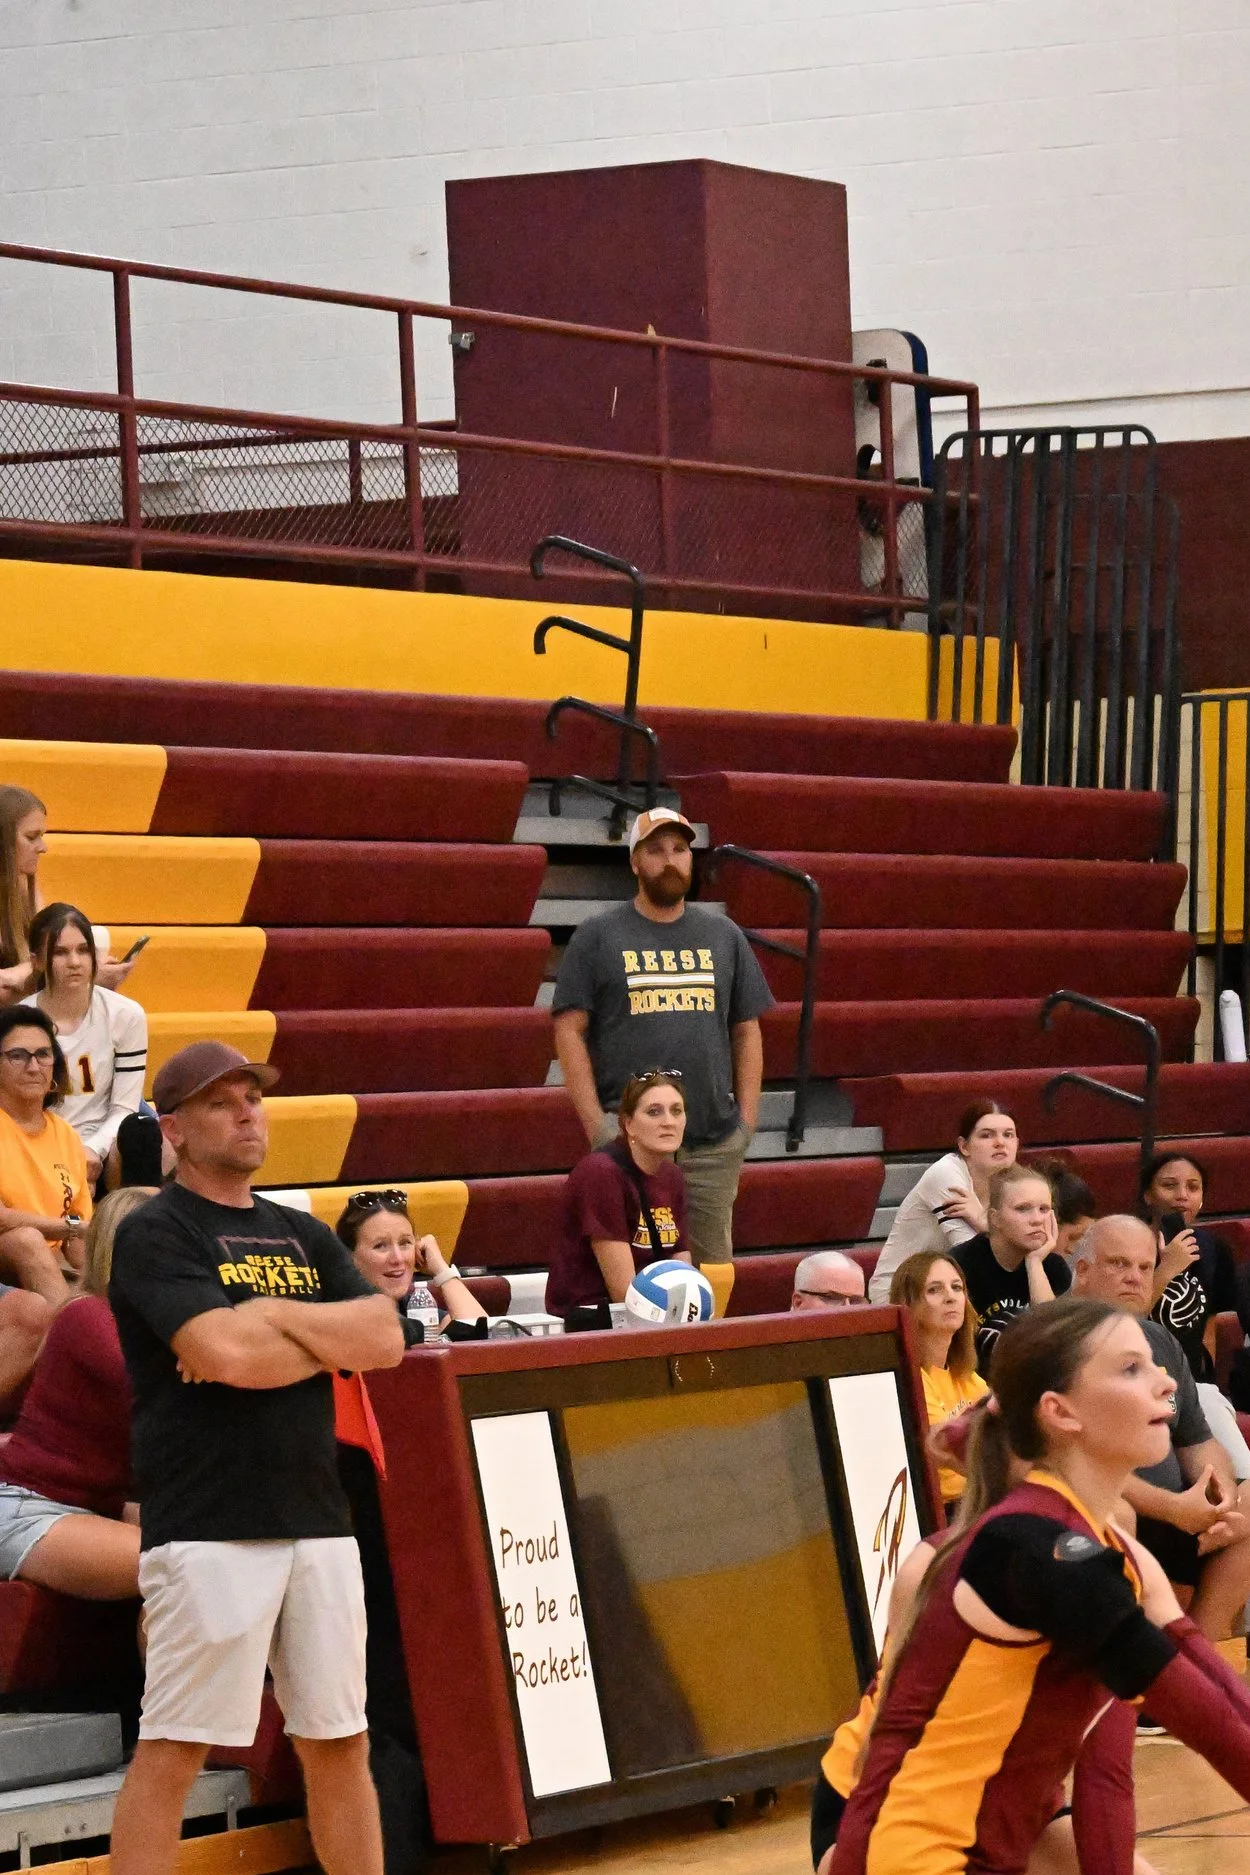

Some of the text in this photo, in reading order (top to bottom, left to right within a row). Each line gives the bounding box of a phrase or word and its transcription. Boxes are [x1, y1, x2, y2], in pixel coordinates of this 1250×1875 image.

[622, 949, 714, 973] REESE
[628, 988, 715, 1015] ROCKETS
[245, 1254, 295, 1267] REESE
[500, 1520, 560, 1569] Proud
[501, 1587, 580, 1629] to be a
[513, 1641, 588, 1688] Rocket!
